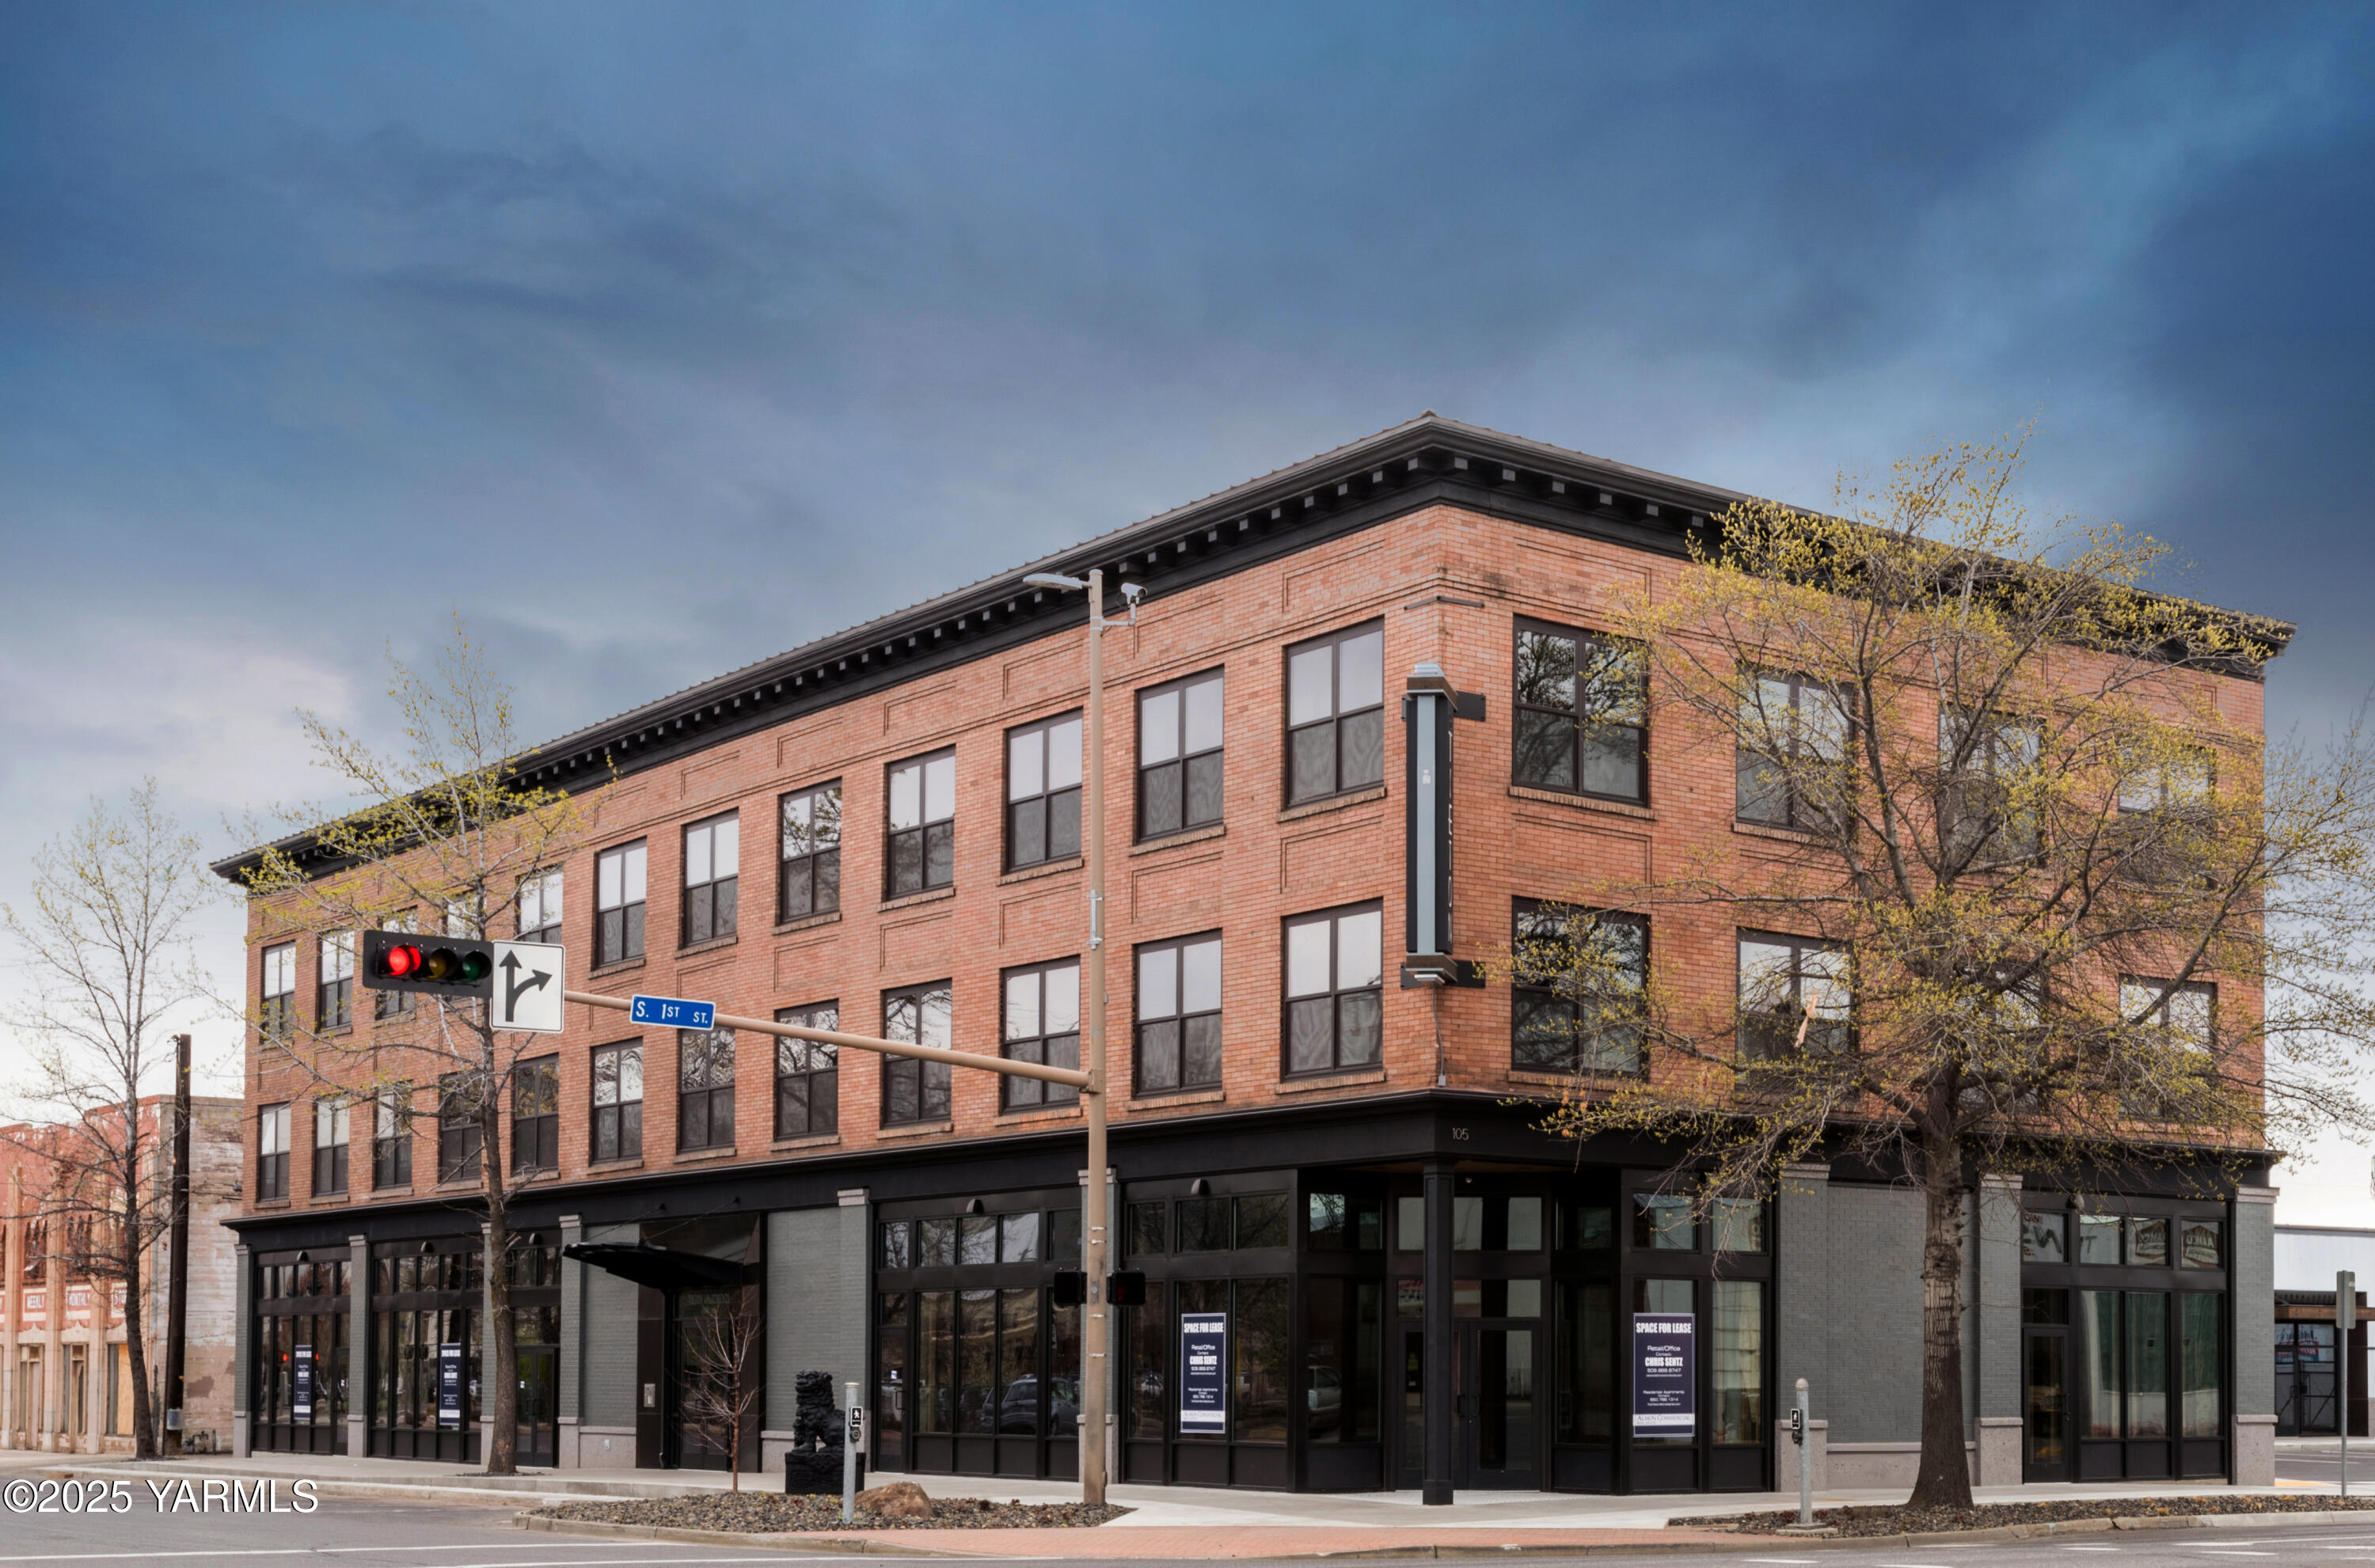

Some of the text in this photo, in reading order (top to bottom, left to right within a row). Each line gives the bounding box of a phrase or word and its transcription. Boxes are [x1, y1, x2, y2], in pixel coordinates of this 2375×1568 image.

[636, 1001, 708, 1023] S. 1ST ST.
[1453, 1127, 1469, 1141] 105
[1636, 1323, 1692, 1334] SPACE FOR LEASE
[1644, 1357, 1664, 1367] CHRIS
